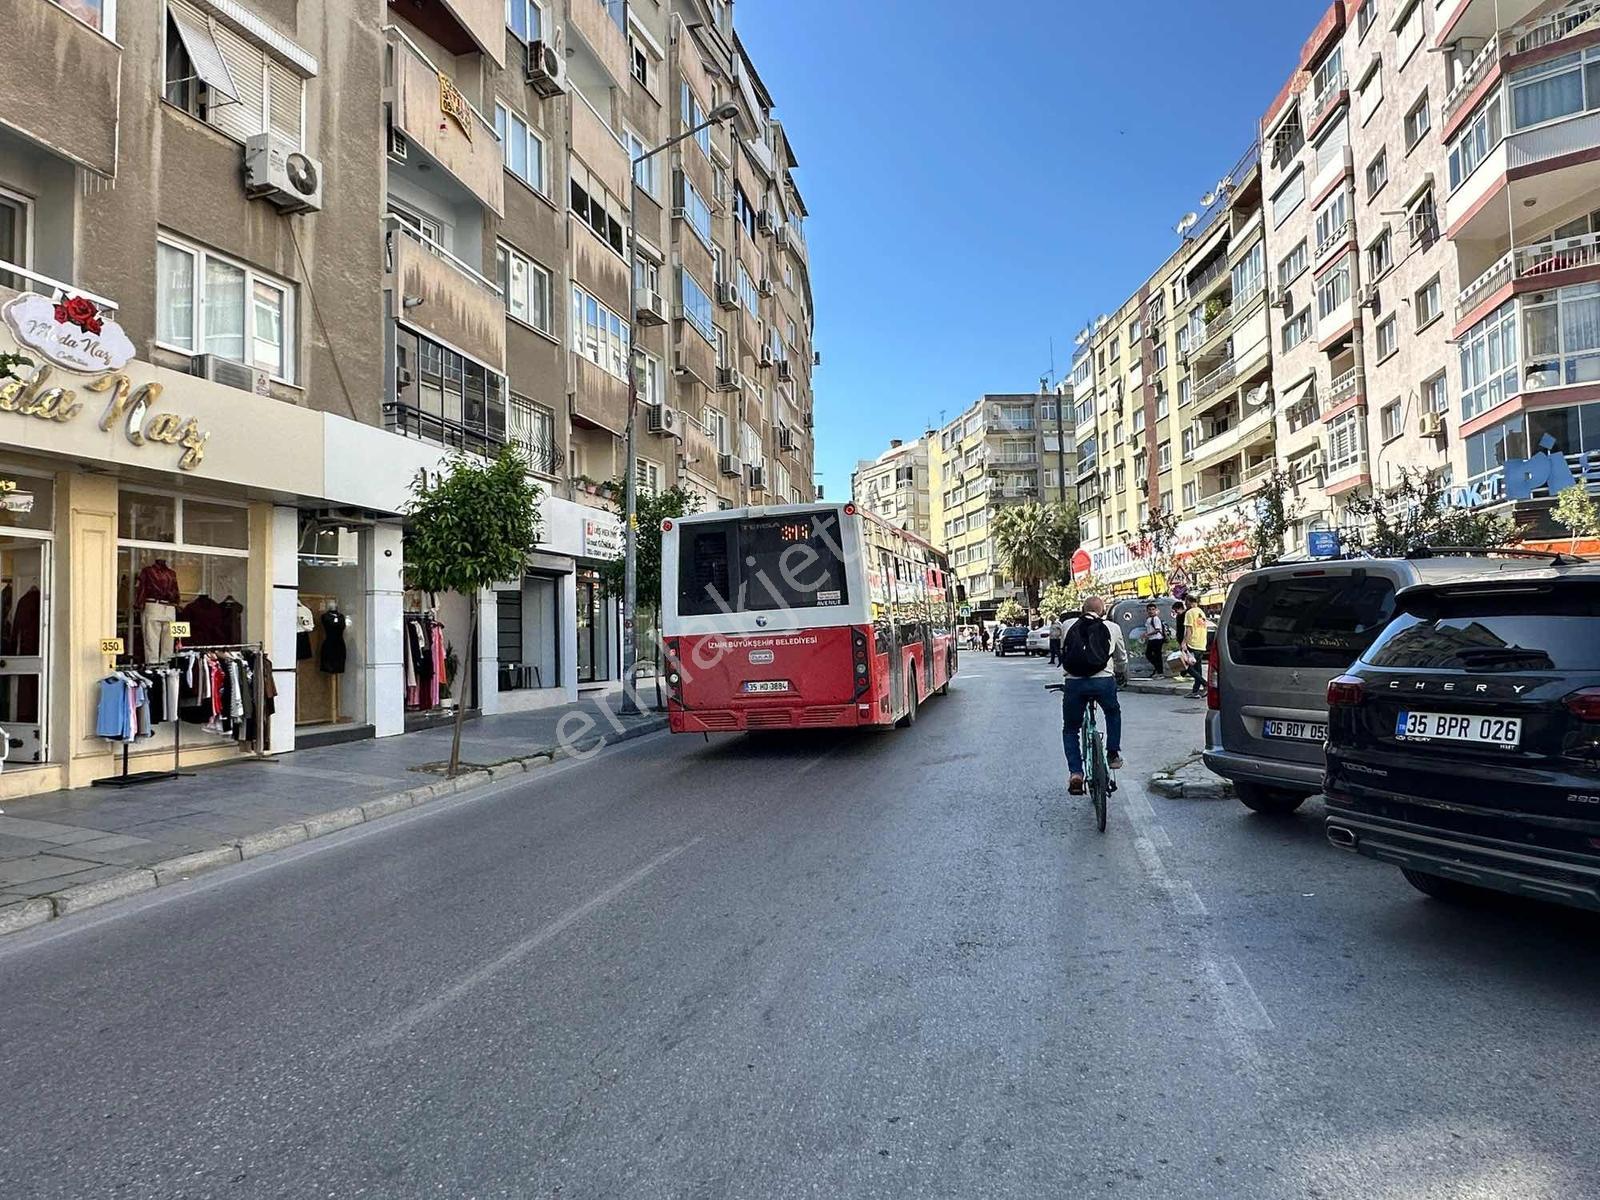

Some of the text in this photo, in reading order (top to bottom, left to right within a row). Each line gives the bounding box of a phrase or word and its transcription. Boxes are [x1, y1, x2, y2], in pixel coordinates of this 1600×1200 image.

[81, 338, 113, 366] Naz
[82, 374, 211, 470] Naz
[1093, 545, 1126, 572] BRITISH
[171, 625, 187, 635] 350
[102, 641, 119, 652] 350
[707, 635, 818, 649] İZMİR BÜYÜKŞEHİR BELEDİYESİ
[749, 682, 758, 691] 35
[1389, 681, 1525, 693] CHERY
[1270, 721, 1283, 735] 06
[1286, 723, 1305, 737] BDY
[1407, 714, 1518, 741] 35 BPR 026
[1567, 793, 1599, 804] 290
